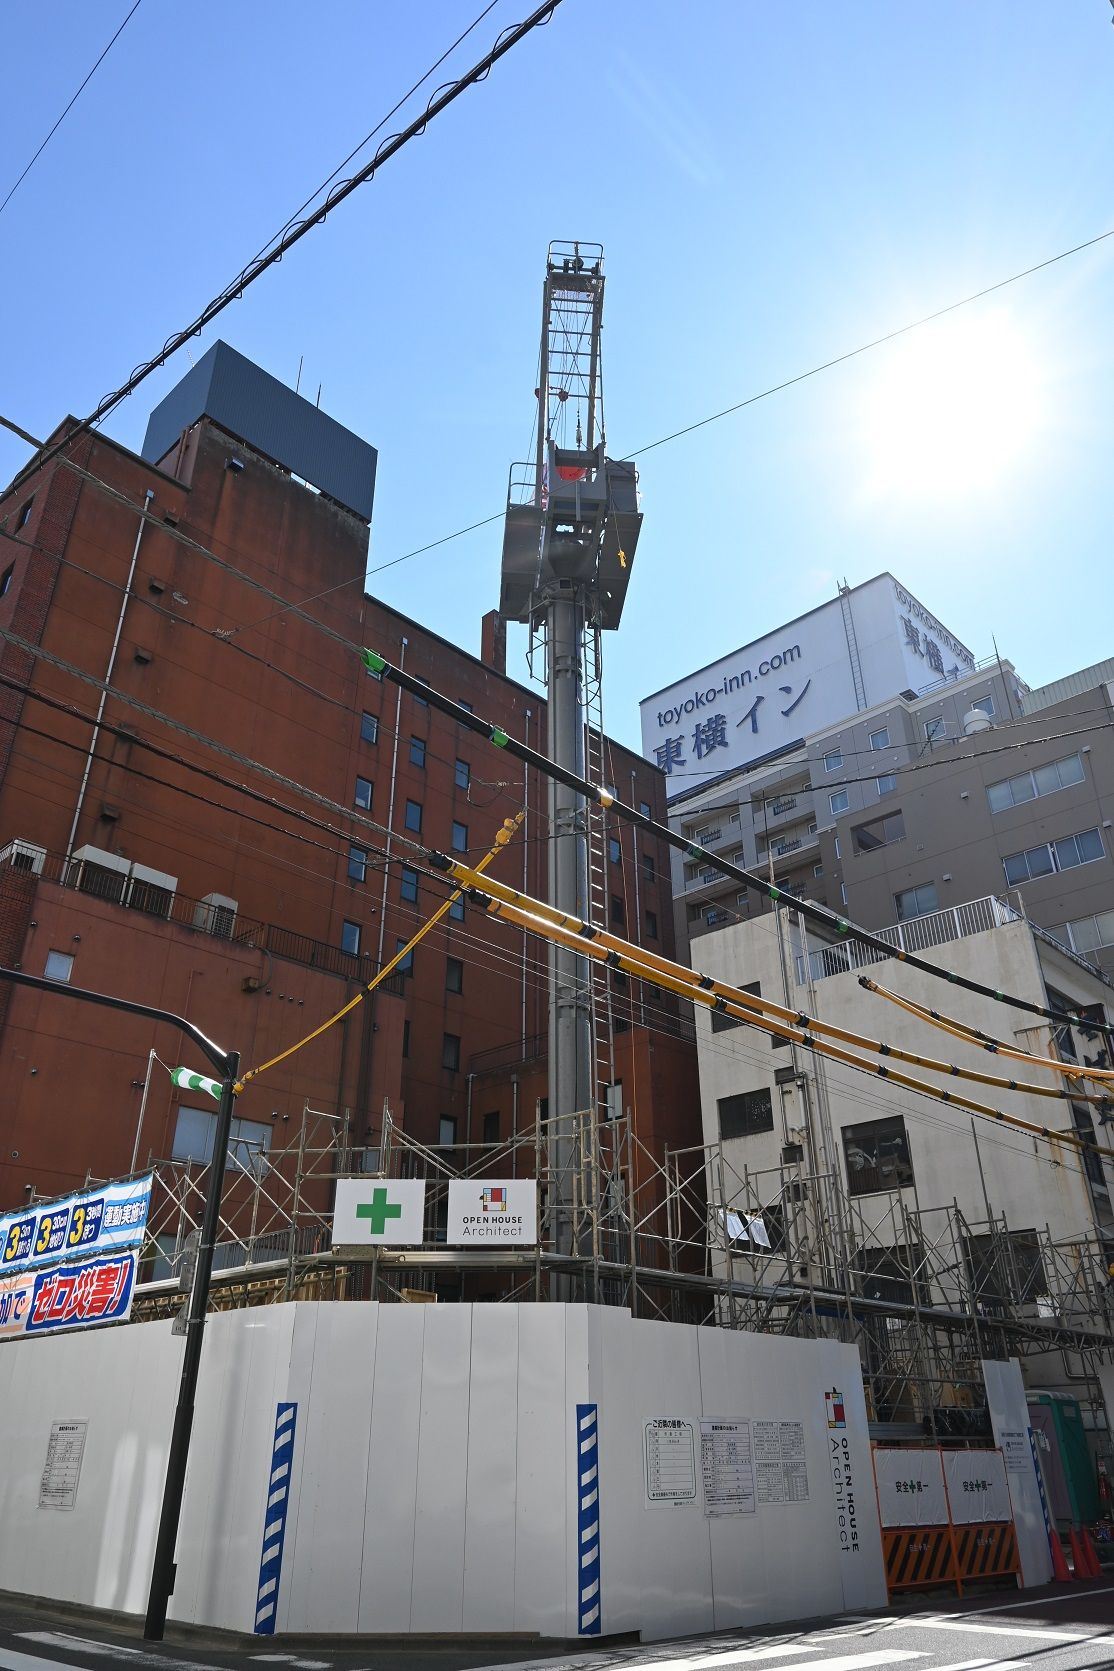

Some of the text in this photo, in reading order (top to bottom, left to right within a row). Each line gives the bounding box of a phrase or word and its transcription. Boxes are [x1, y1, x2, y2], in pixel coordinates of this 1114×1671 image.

[894, 583, 975, 671] toyoko-inn.com
[657, 644, 802, 728] toyoko-inn.com
[653, 679, 811, 775] 東横イン
[70, 1208, 85, 1244] 3
[105, 1202, 147, 1227] 運動実施中
[462, 1216, 523, 1224] OPEN HOUSE
[462, 1226, 522, 1236] Architect
[5, 1226, 21, 1260] 3
[36, 1217, 52, 1252] 3
[830, 1438, 850, 1552] Architect
[842, 1437, 860, 1552] OPEN HOUSE
